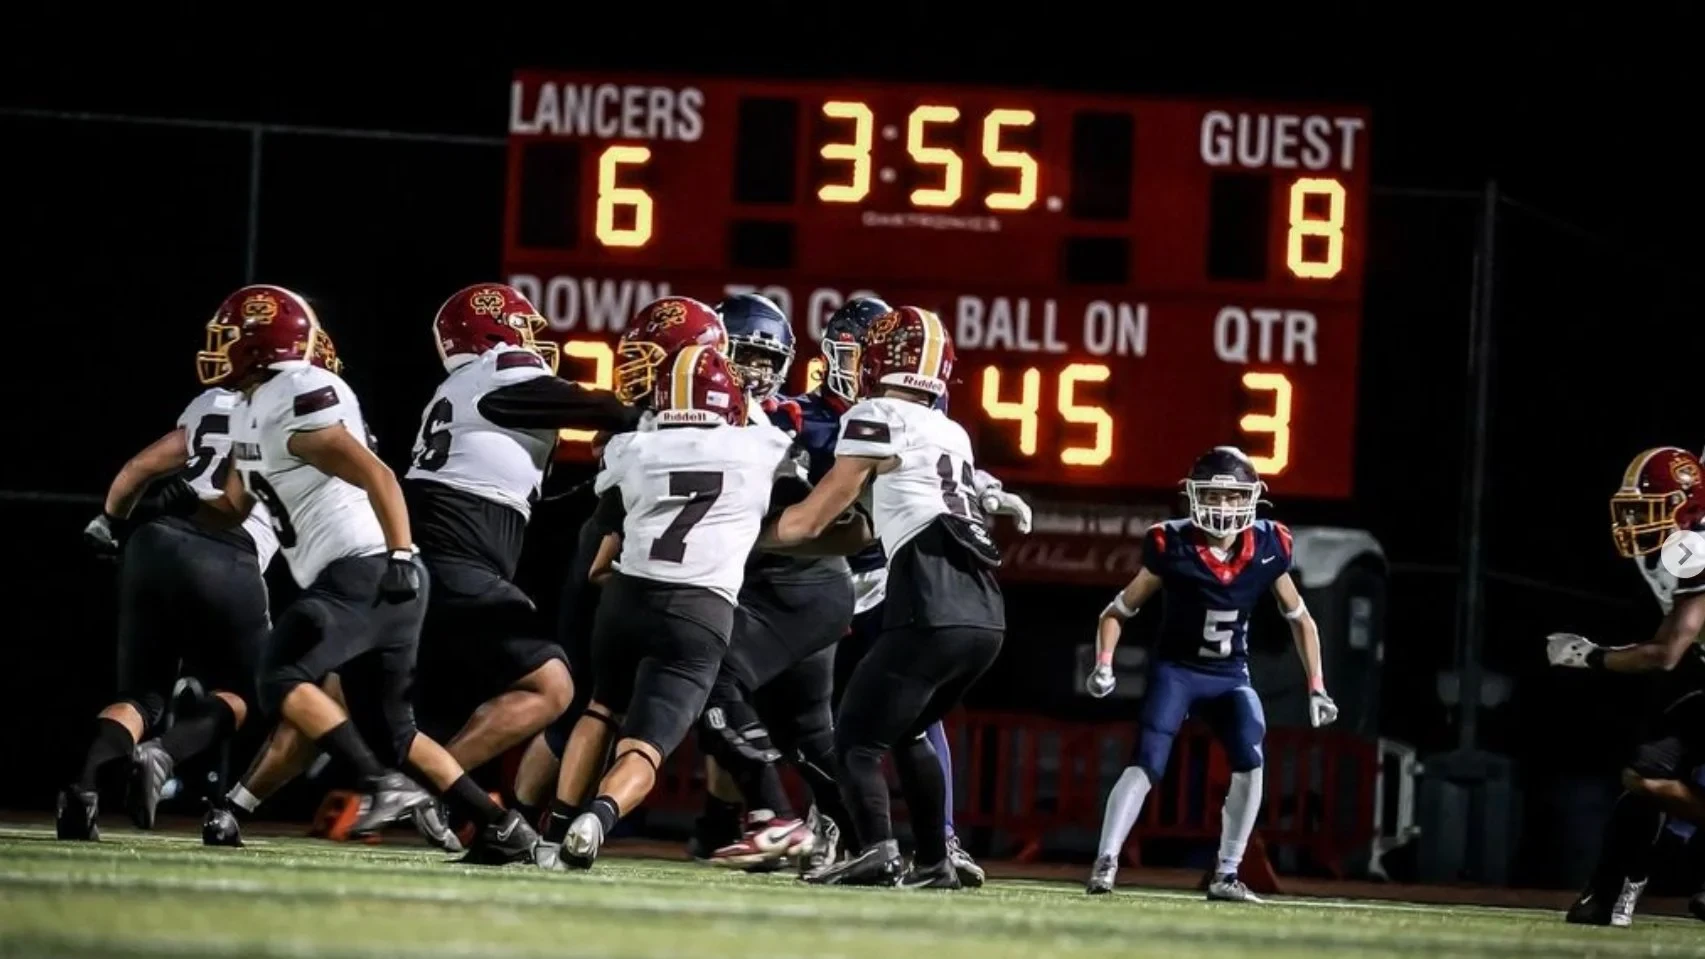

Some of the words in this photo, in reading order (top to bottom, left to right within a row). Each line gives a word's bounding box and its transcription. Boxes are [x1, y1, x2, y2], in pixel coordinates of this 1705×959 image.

[509, 80, 705, 142] LANCERS
[1200, 110, 1365, 171] GUEST
[596, 146, 653, 247] 6
[1287, 178, 1345, 278] 8
[956, 295, 1068, 352] BALL
[1083, 301, 1148, 356] ON
[1213, 306, 1318, 365] QTR
[663, 411, 707, 422] Riddell
[982, 363, 1113, 466] 45
[1239, 372, 1292, 474] 3
[649, 470, 724, 564] 7
[1197, 608, 1240, 658] 5
